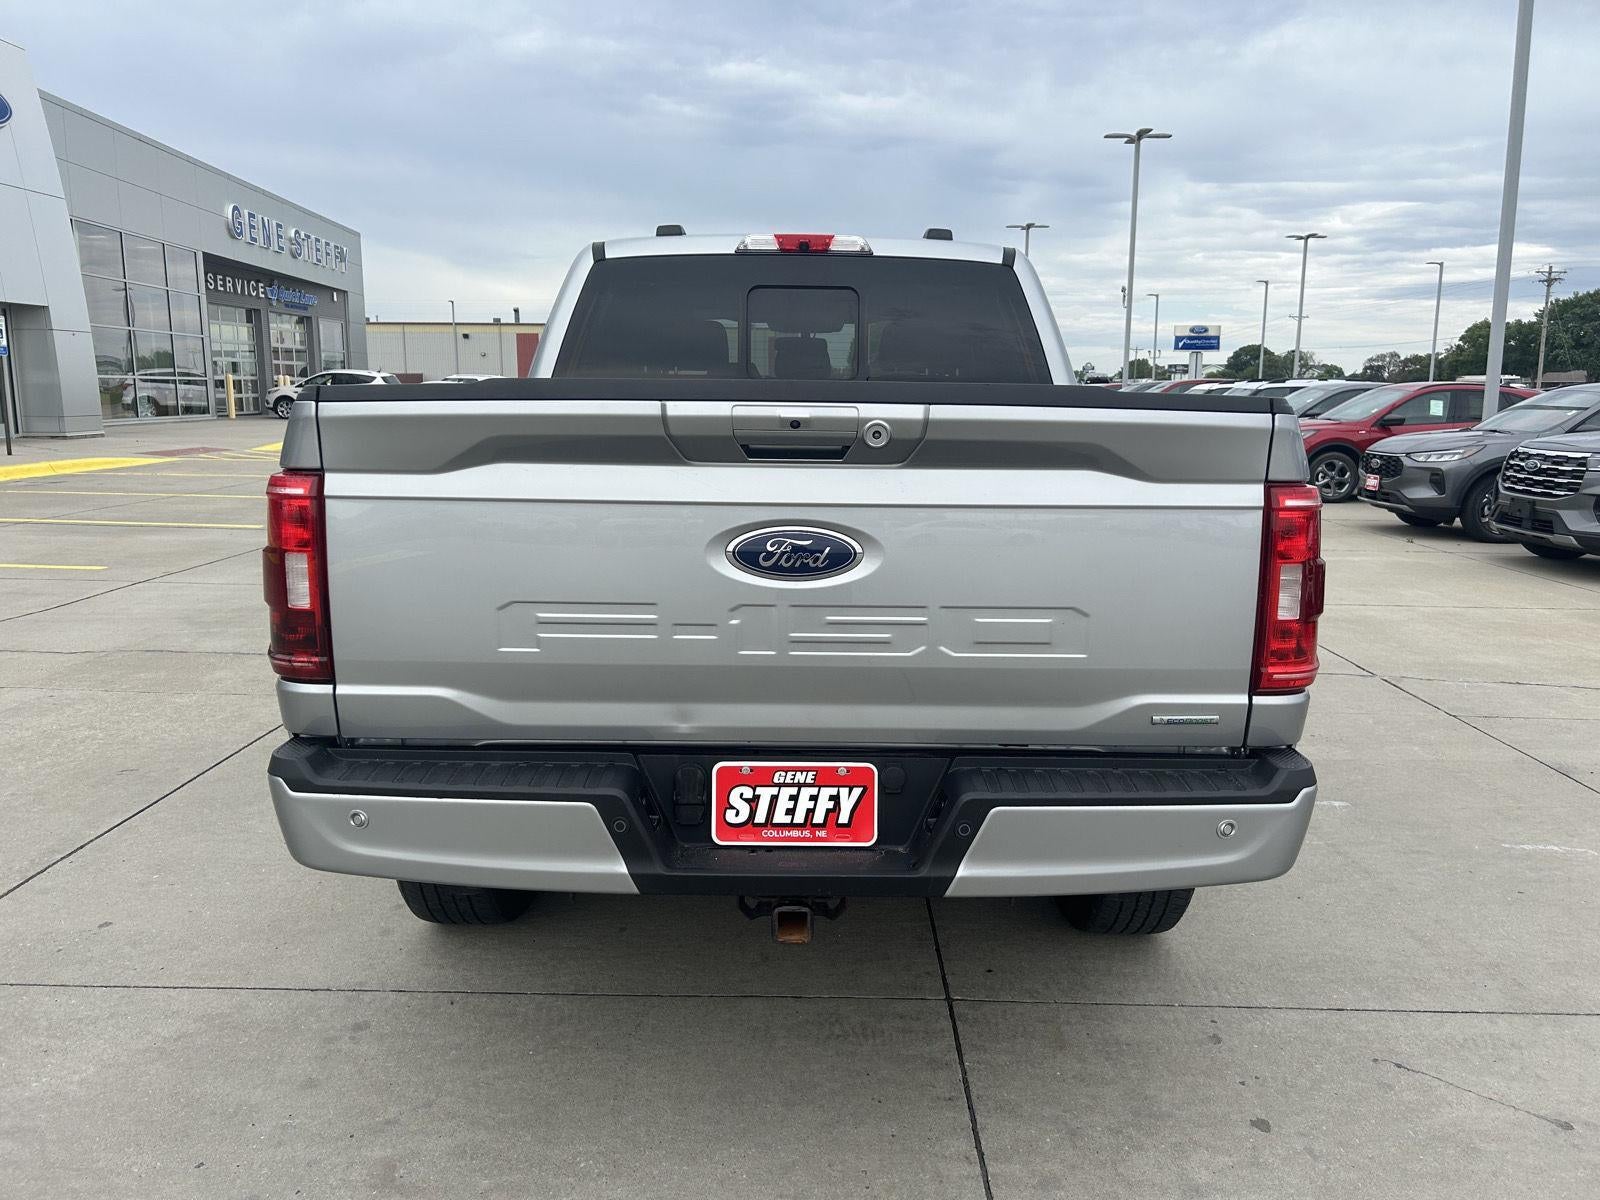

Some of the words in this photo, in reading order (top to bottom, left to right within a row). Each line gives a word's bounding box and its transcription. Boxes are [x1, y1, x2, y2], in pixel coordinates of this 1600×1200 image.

[227, 204, 284, 253] GENE
[290, 227, 349, 273] STEFFY
[206, 272, 265, 298] SERVICE
[758, 537, 831, 568] Ford
[496, 601, 1091, 659] F-150
[772, 770, 817, 785] GENE
[724, 785, 866, 826] STEFFY
[761, 829, 813, 839] COLUMBUS,
[815, 829, 828, 838] NE
